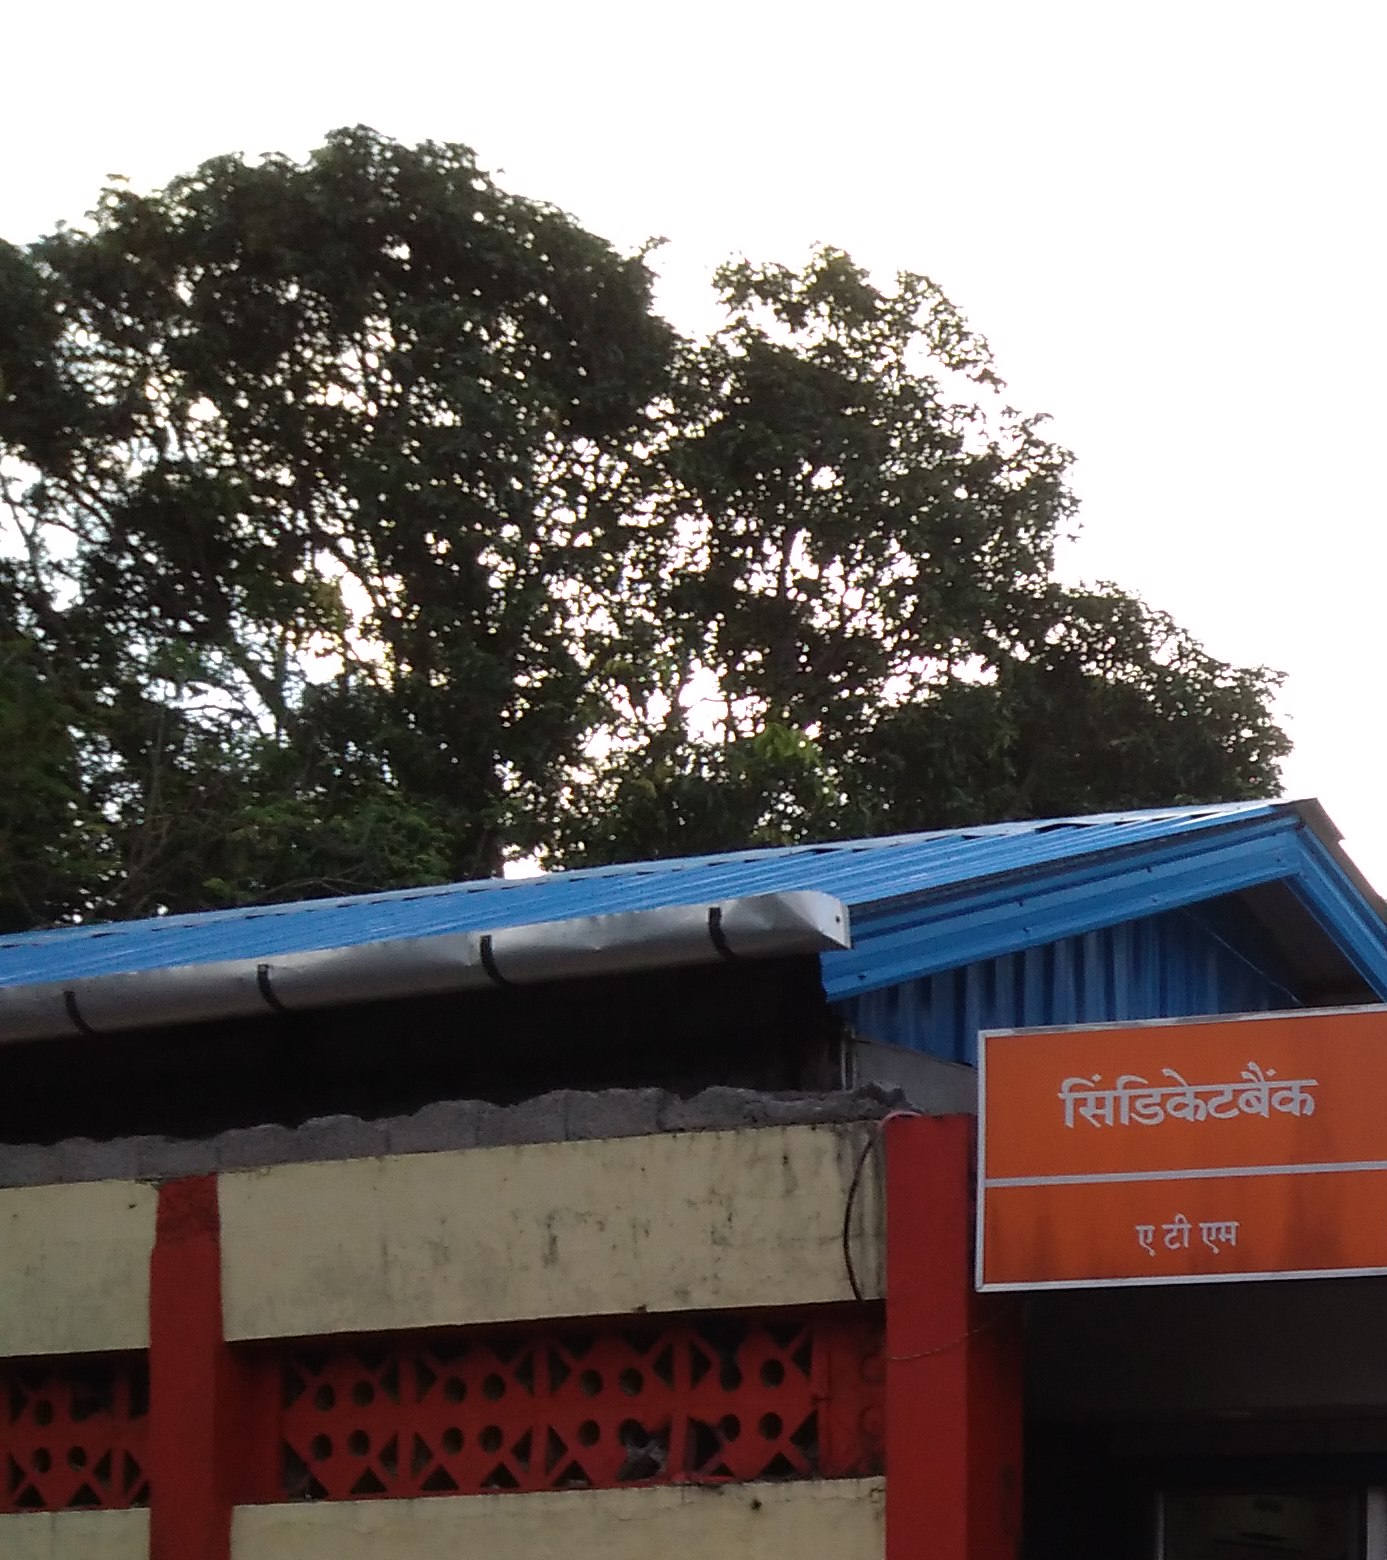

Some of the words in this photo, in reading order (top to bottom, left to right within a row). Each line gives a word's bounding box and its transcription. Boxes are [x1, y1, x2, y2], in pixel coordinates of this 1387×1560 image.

[1058, 1061, 1319, 1129] सिंडिकेटबैंक
[1136, 1225, 1156, 1257] ए
[1162, 1213, 1192, 1249] टी
[1199, 1221, 1240, 1255] एम
